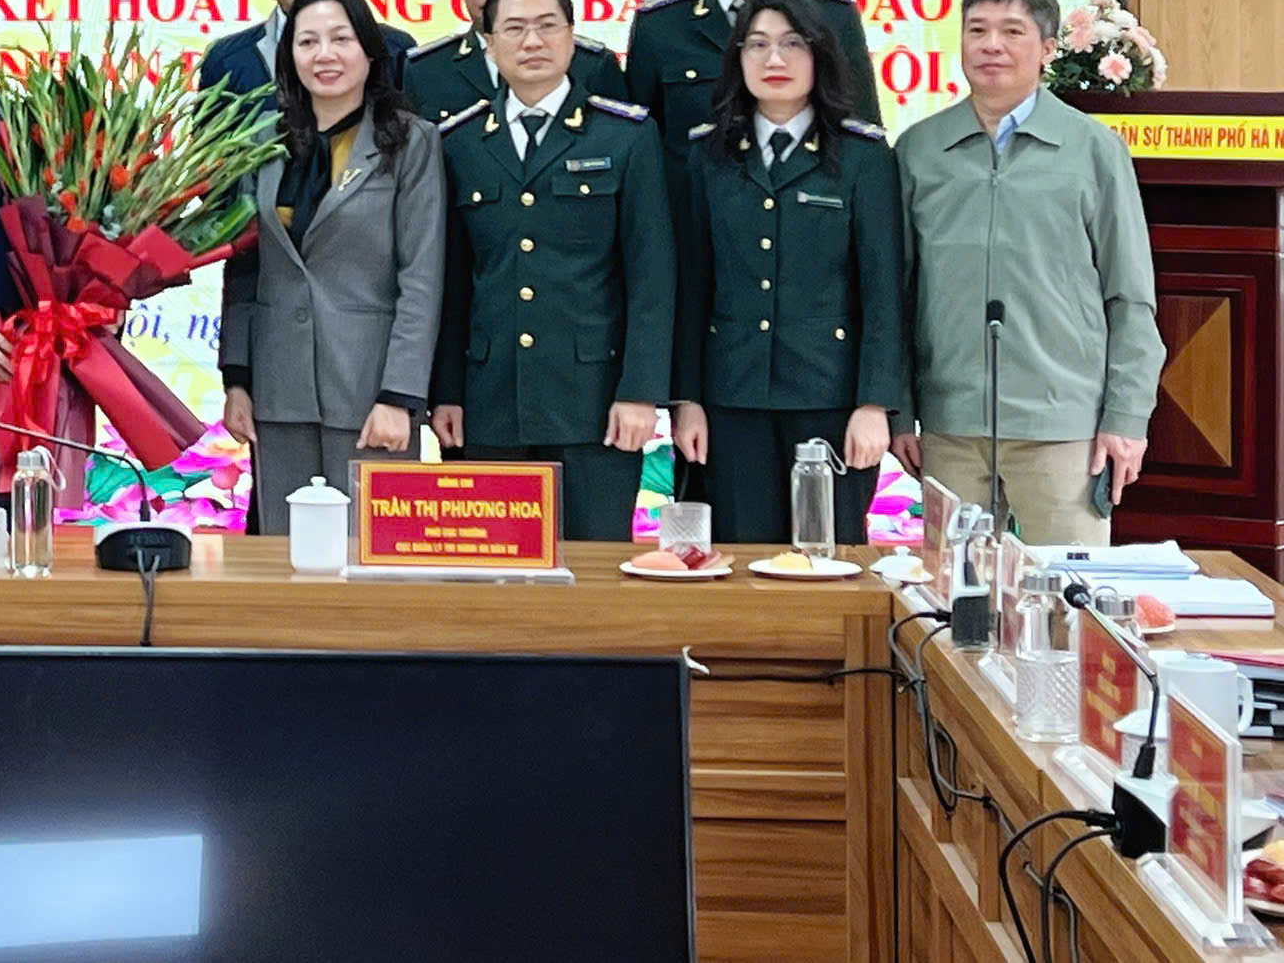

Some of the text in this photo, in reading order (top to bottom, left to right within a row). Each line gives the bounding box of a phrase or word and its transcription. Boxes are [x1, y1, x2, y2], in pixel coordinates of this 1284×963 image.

[869, 44, 959, 106] ỘI,
[1111, 121, 1138, 146] ÂN
[1166, 122, 1213, 148] THÀNH
[126, 303, 170, 346] ội,
[415, 500, 438, 521] THỊ
[441, 501, 506, 518] PHƯƠNG
[509, 501, 543, 519] HOA
